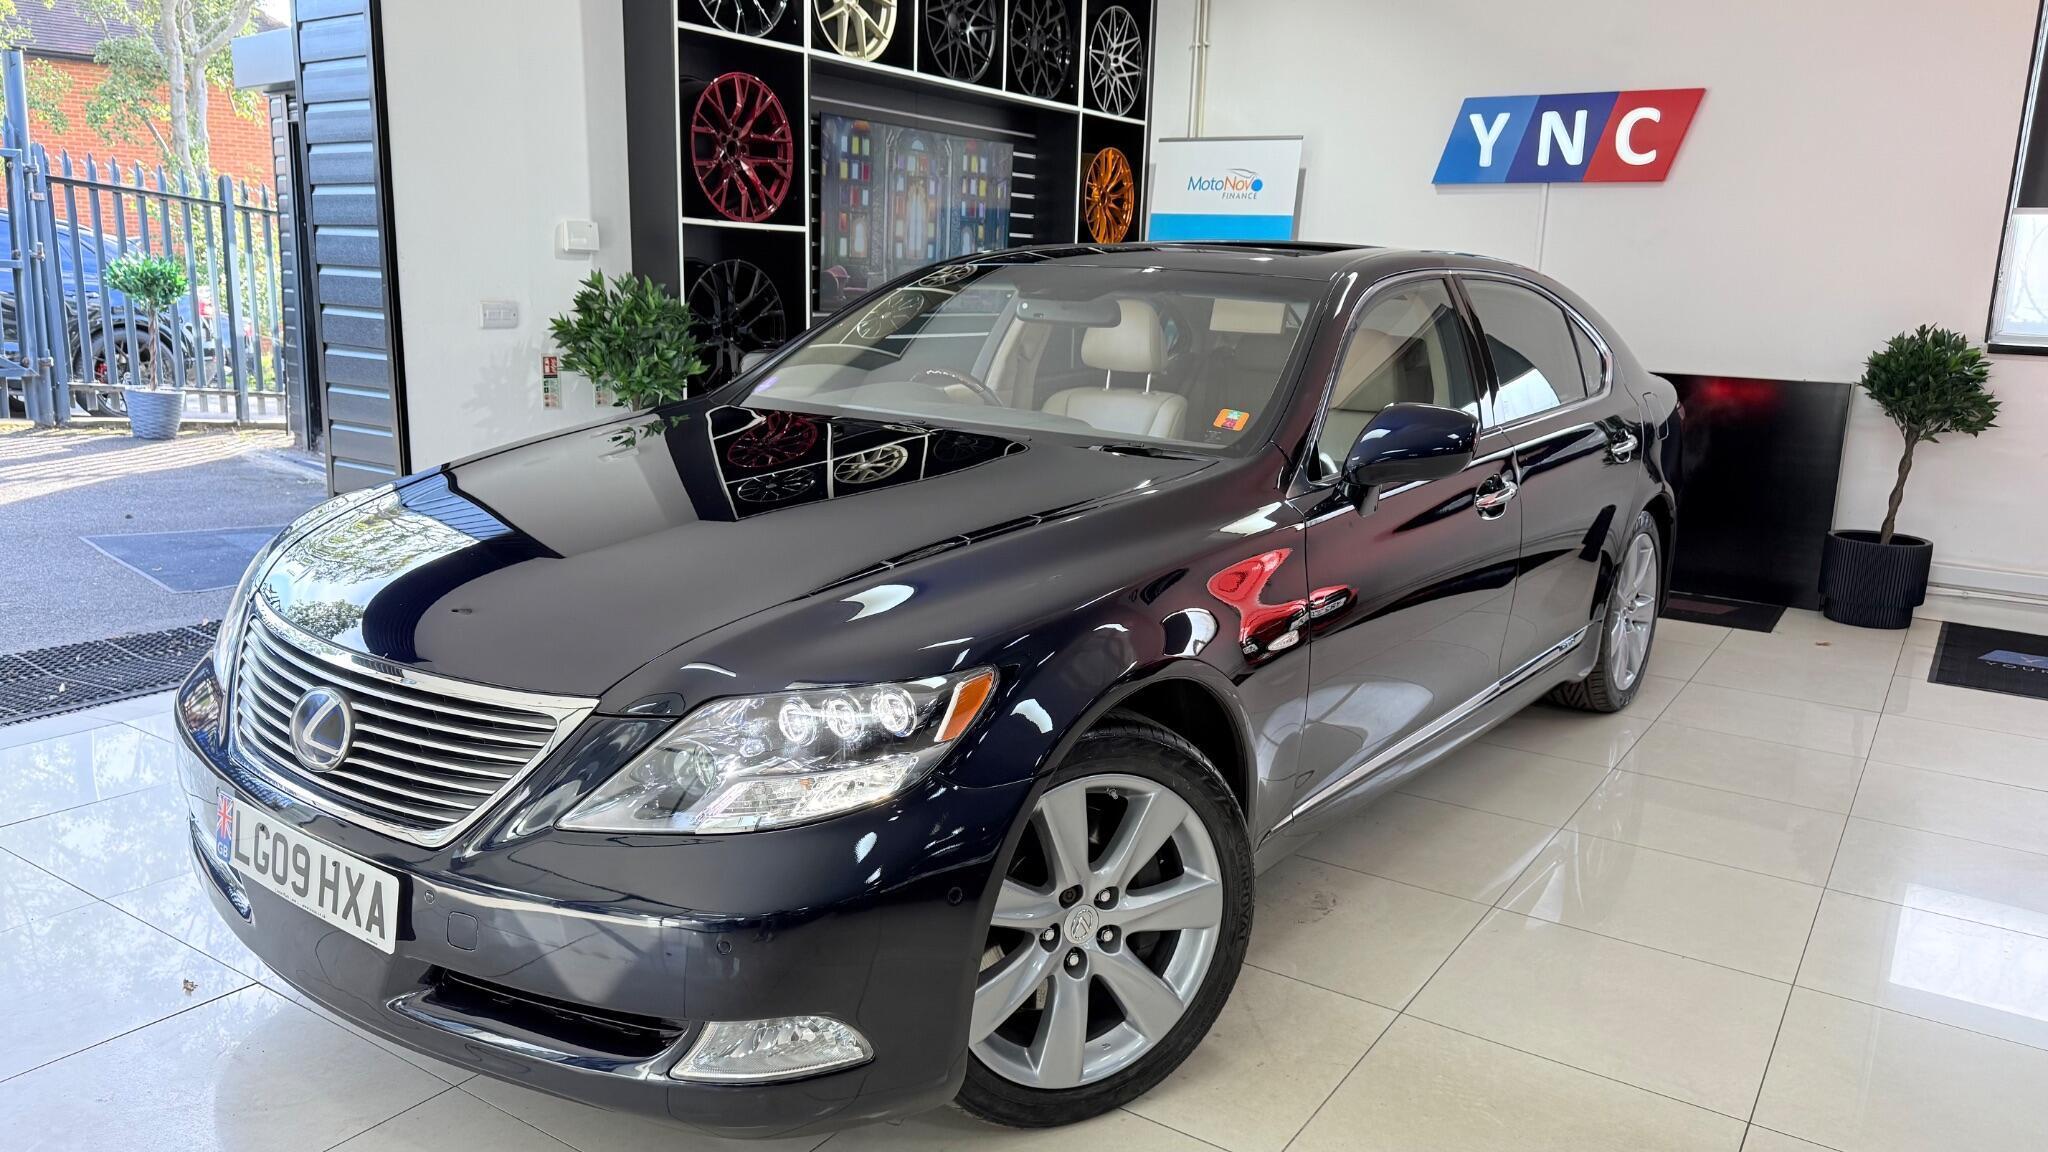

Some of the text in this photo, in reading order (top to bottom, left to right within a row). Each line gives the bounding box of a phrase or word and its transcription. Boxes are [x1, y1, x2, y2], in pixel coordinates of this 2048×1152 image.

[1469, 107, 1661, 167] YNC
[1222, 191, 1257, 200] FINANCE
[217, 841, 229, 858] GB
[234, 809, 386, 940] LG09 HXA
